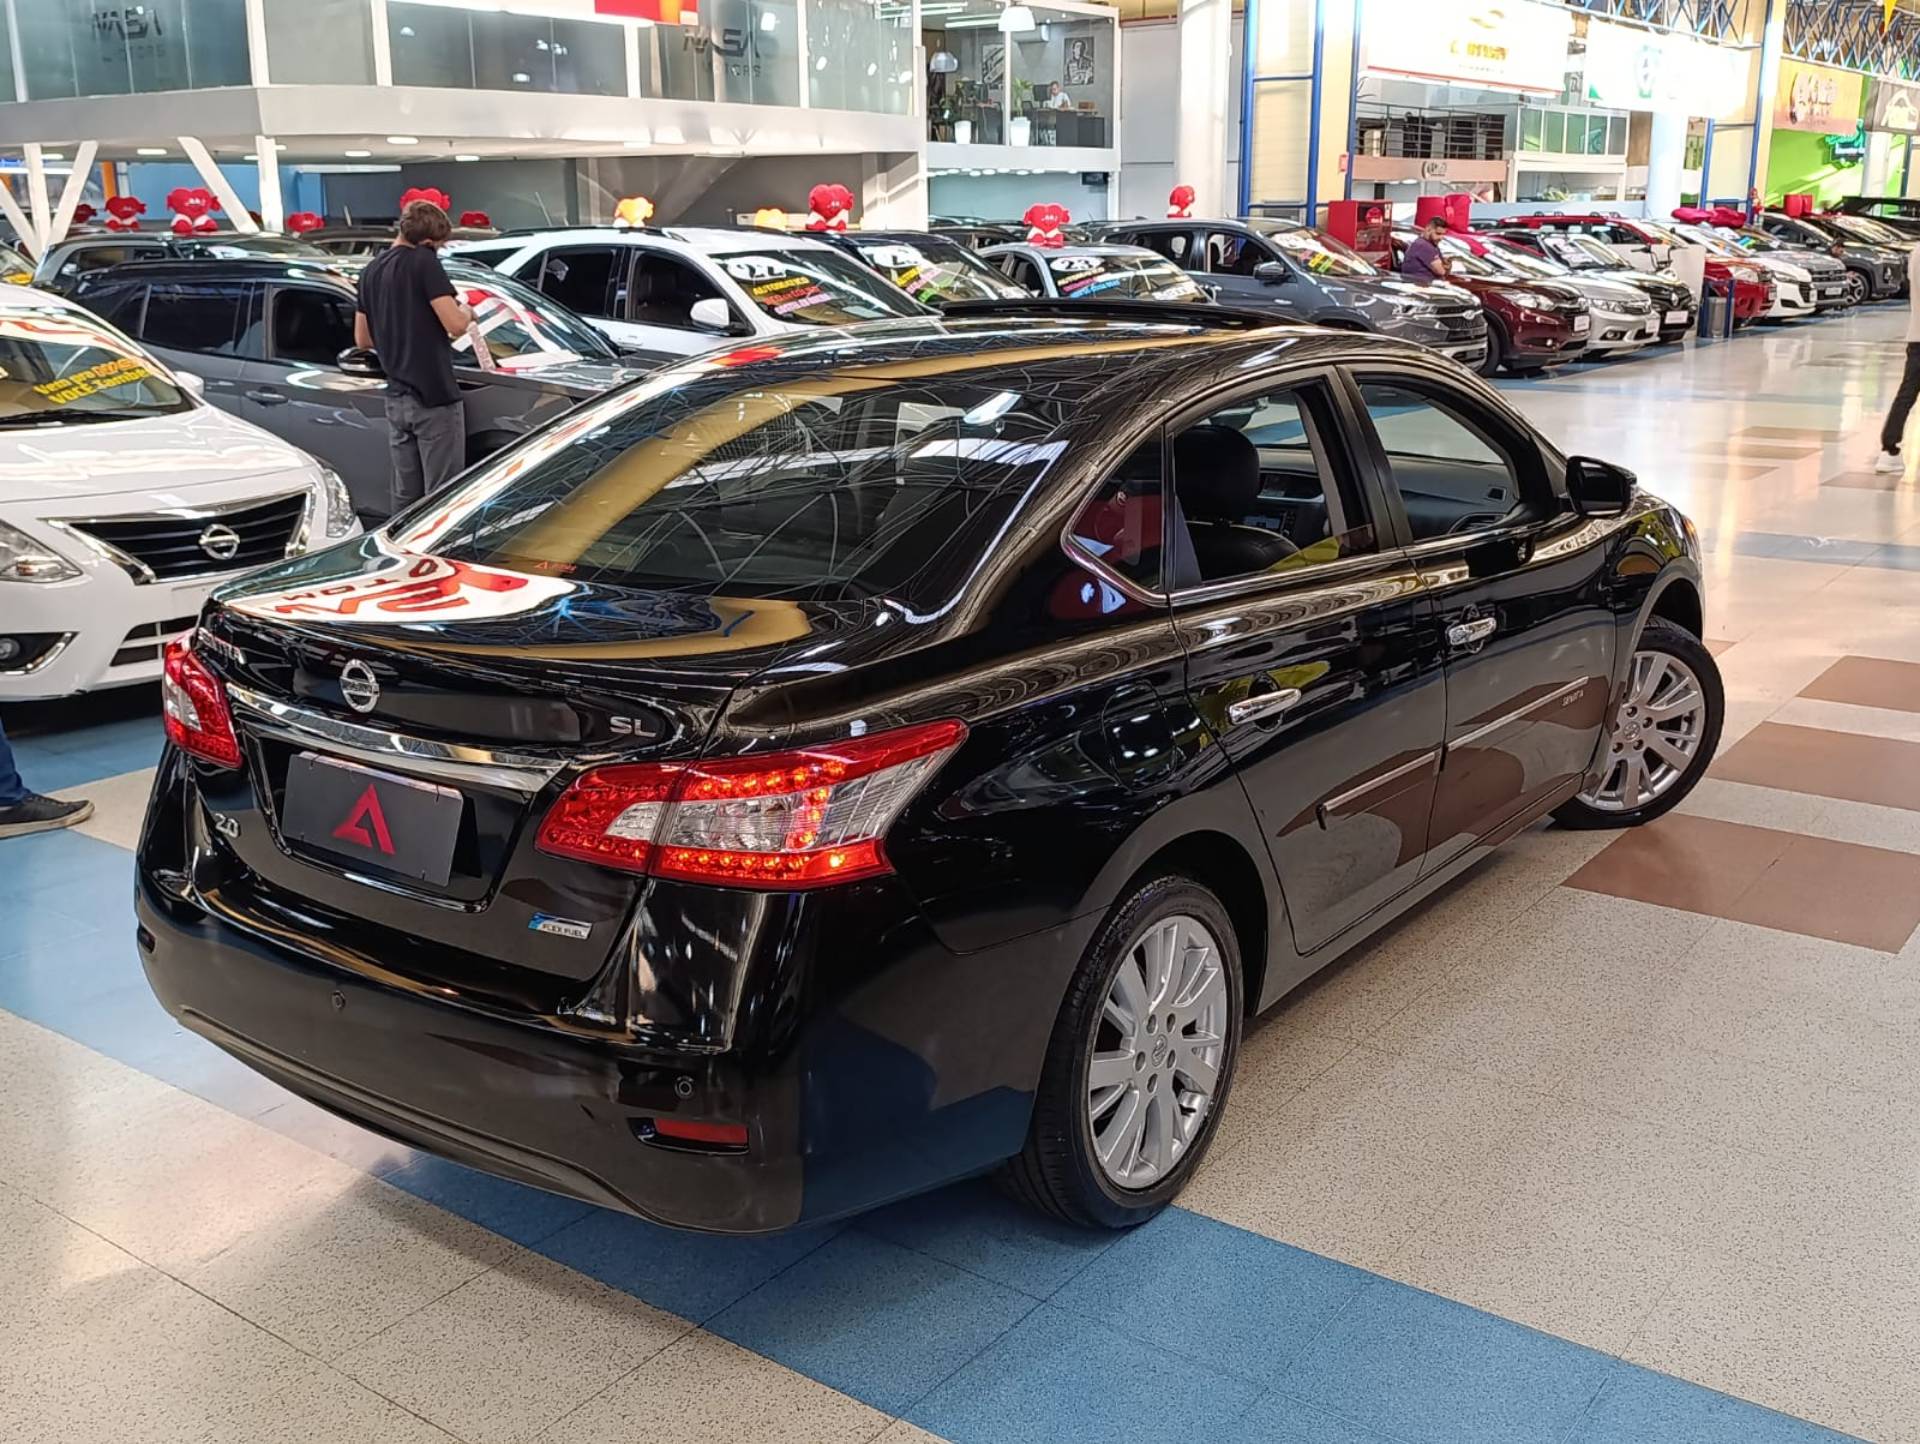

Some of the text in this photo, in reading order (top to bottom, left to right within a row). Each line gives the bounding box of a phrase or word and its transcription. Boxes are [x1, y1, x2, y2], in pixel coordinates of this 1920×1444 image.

[610, 716, 657, 738] SL
[541, 922, 585, 938] FLEX FUEL
